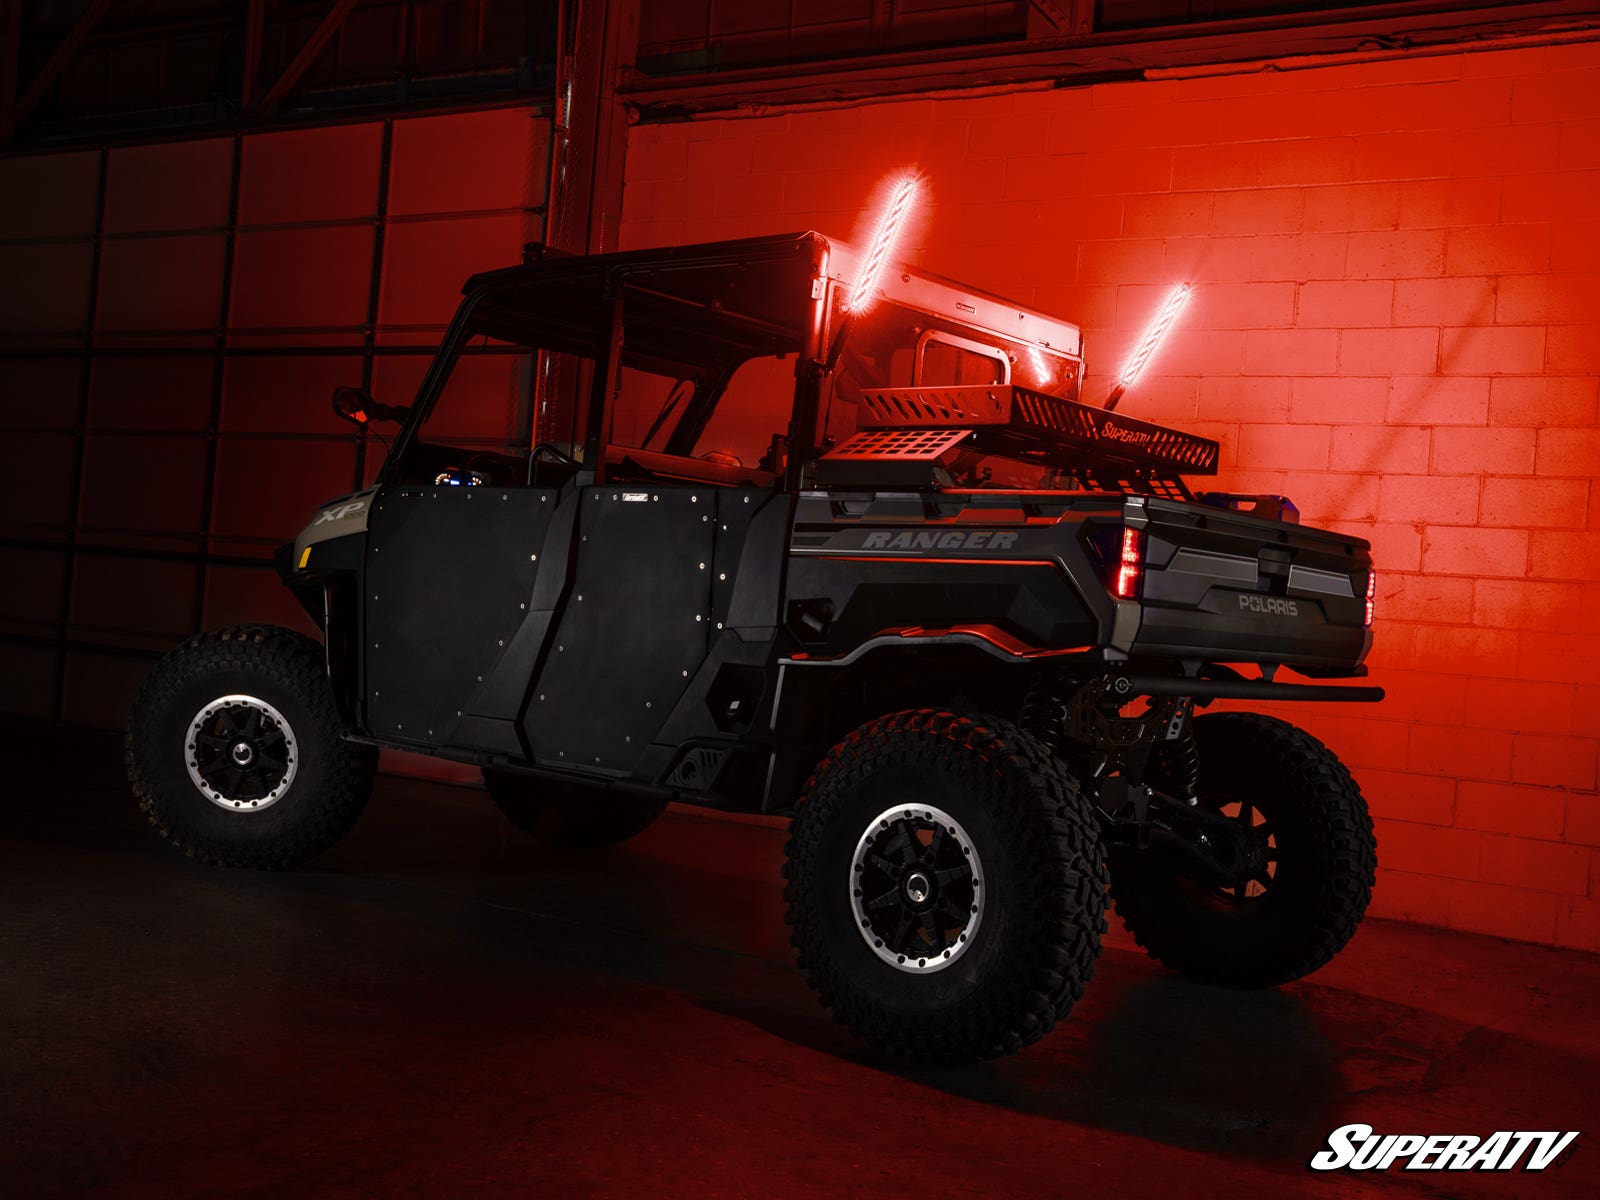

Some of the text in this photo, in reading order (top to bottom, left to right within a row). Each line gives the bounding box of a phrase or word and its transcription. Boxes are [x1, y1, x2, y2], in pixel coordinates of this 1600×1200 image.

[313, 501, 365, 526] XP
[861, 531, 1019, 550] RANGER
[1238, 594, 1298, 617] POLARIS
